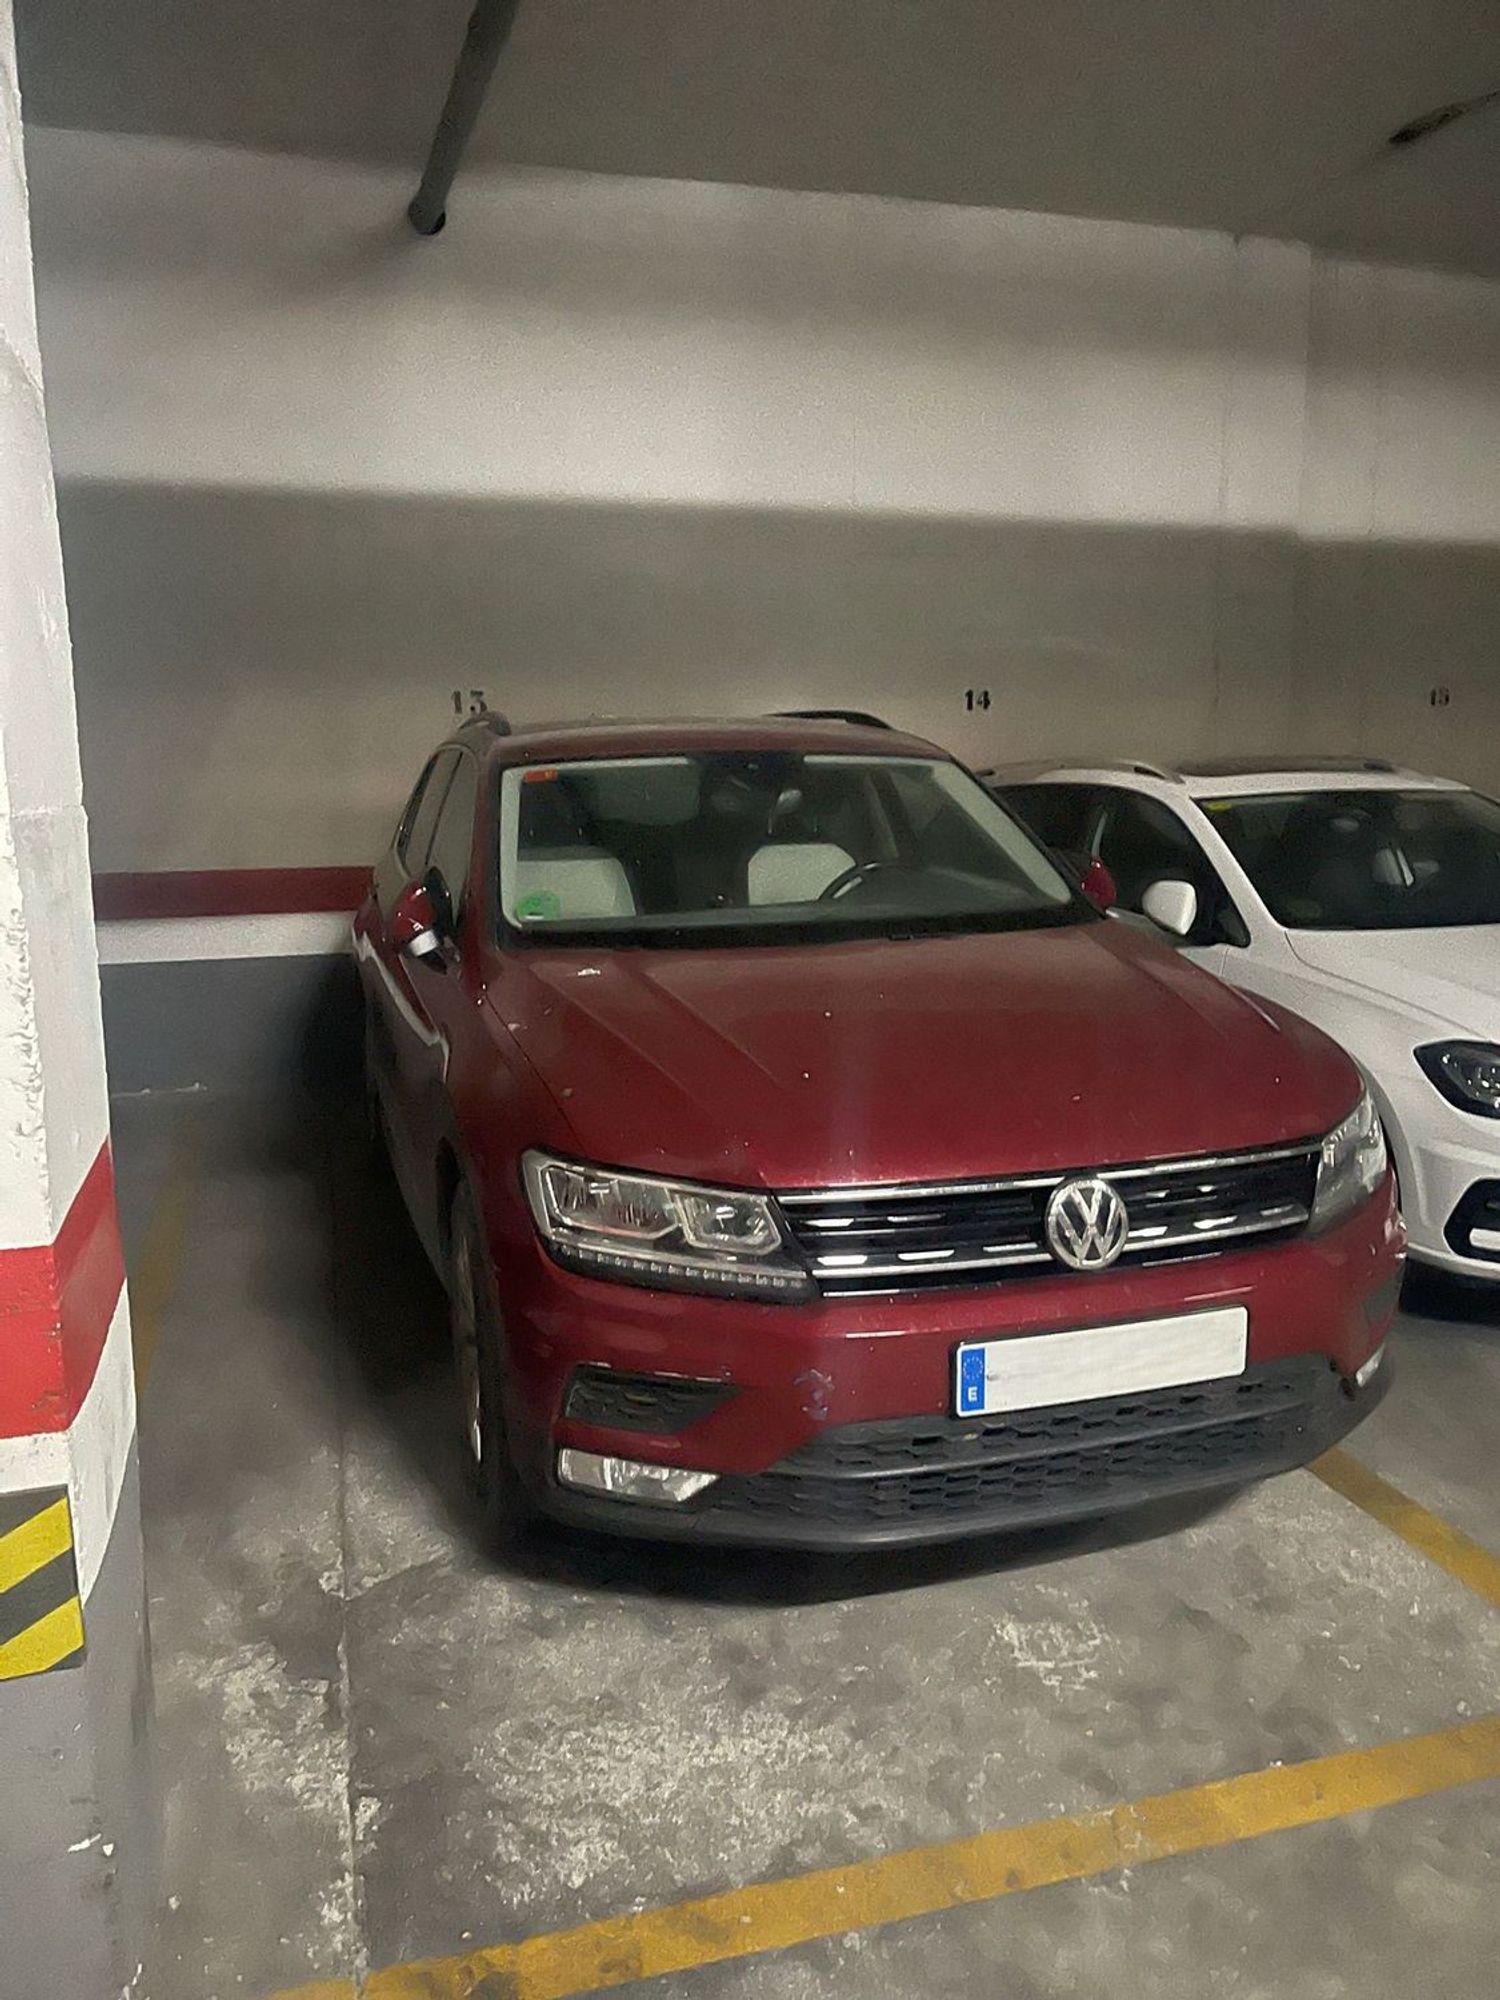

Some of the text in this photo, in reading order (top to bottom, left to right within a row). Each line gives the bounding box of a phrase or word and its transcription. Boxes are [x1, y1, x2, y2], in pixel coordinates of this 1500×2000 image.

[965, 689, 990, 711] 14
[1050, 1181, 1126, 1268] VW
[968, 1386, 978, 1402] E
